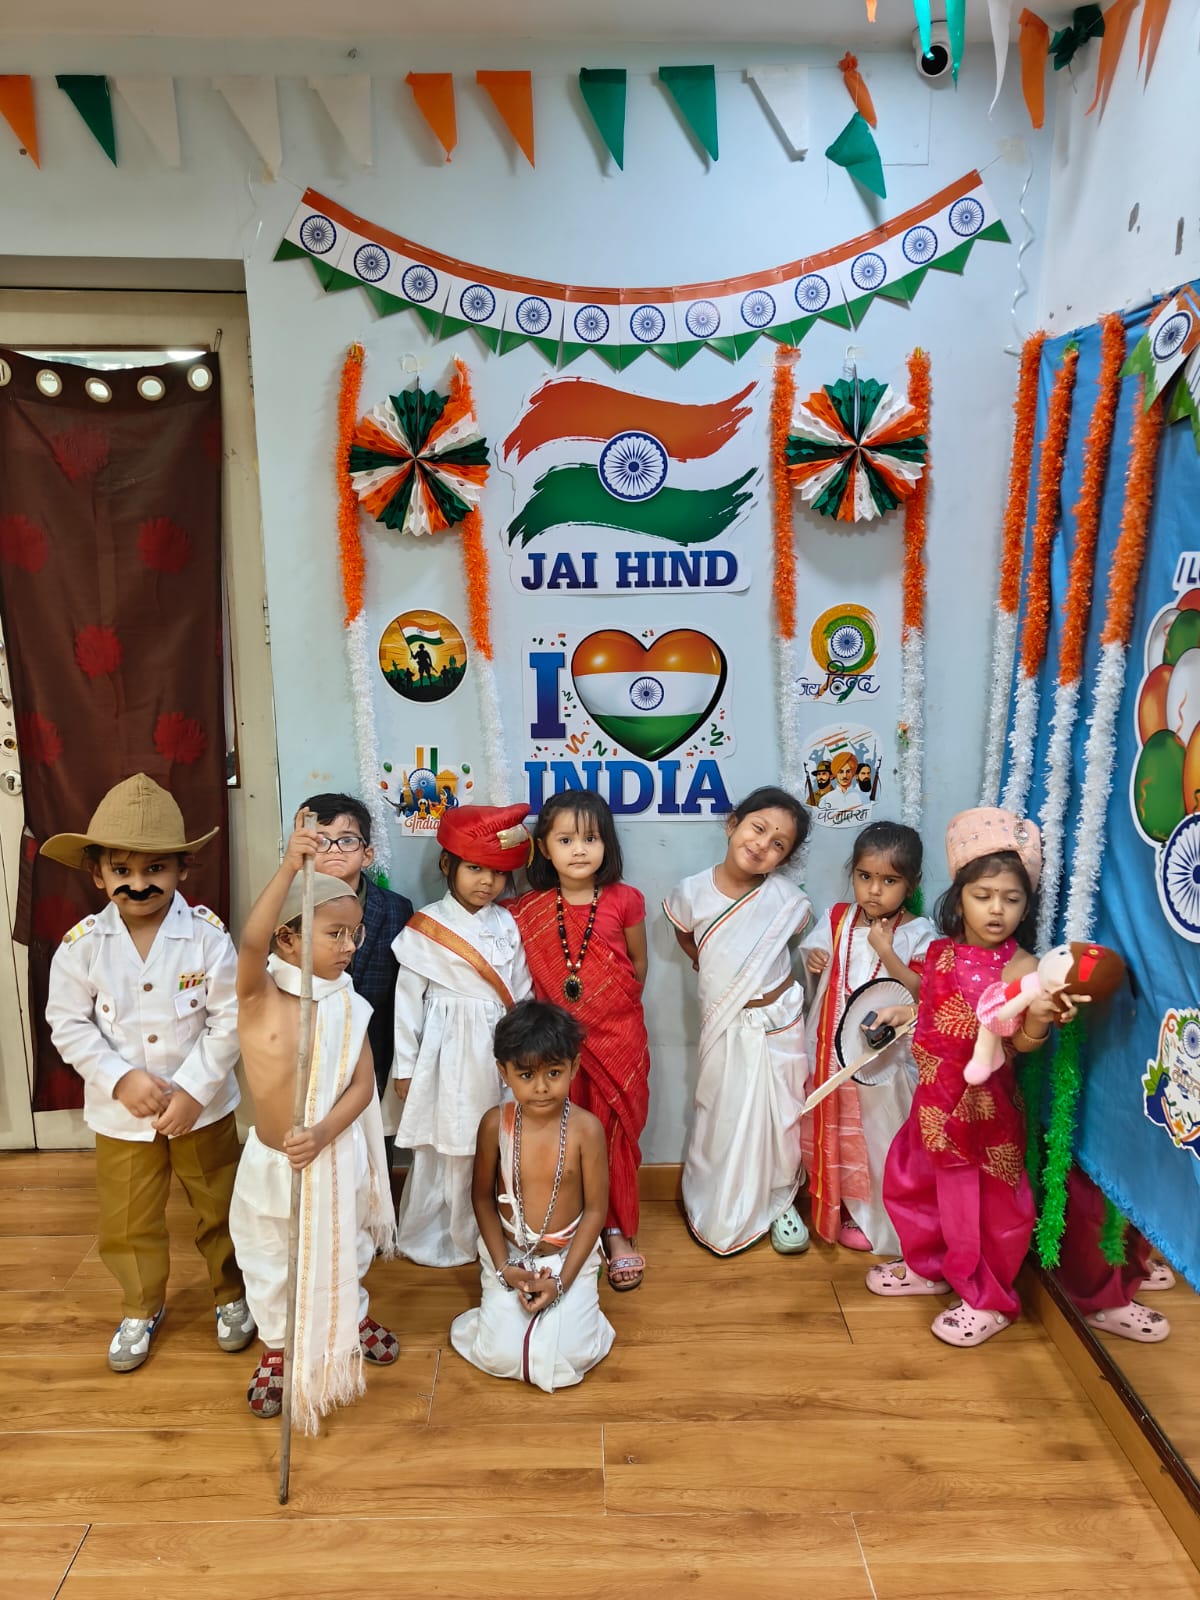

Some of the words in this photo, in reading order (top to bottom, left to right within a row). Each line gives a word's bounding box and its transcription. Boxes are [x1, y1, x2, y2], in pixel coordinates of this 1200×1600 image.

[521, 552, 598, 590] JAI
[615, 550, 738, 588] HIND
[529, 652, 566, 739] I
[524, 760, 733, 815] INDIA
[405, 812, 440, 833] India
